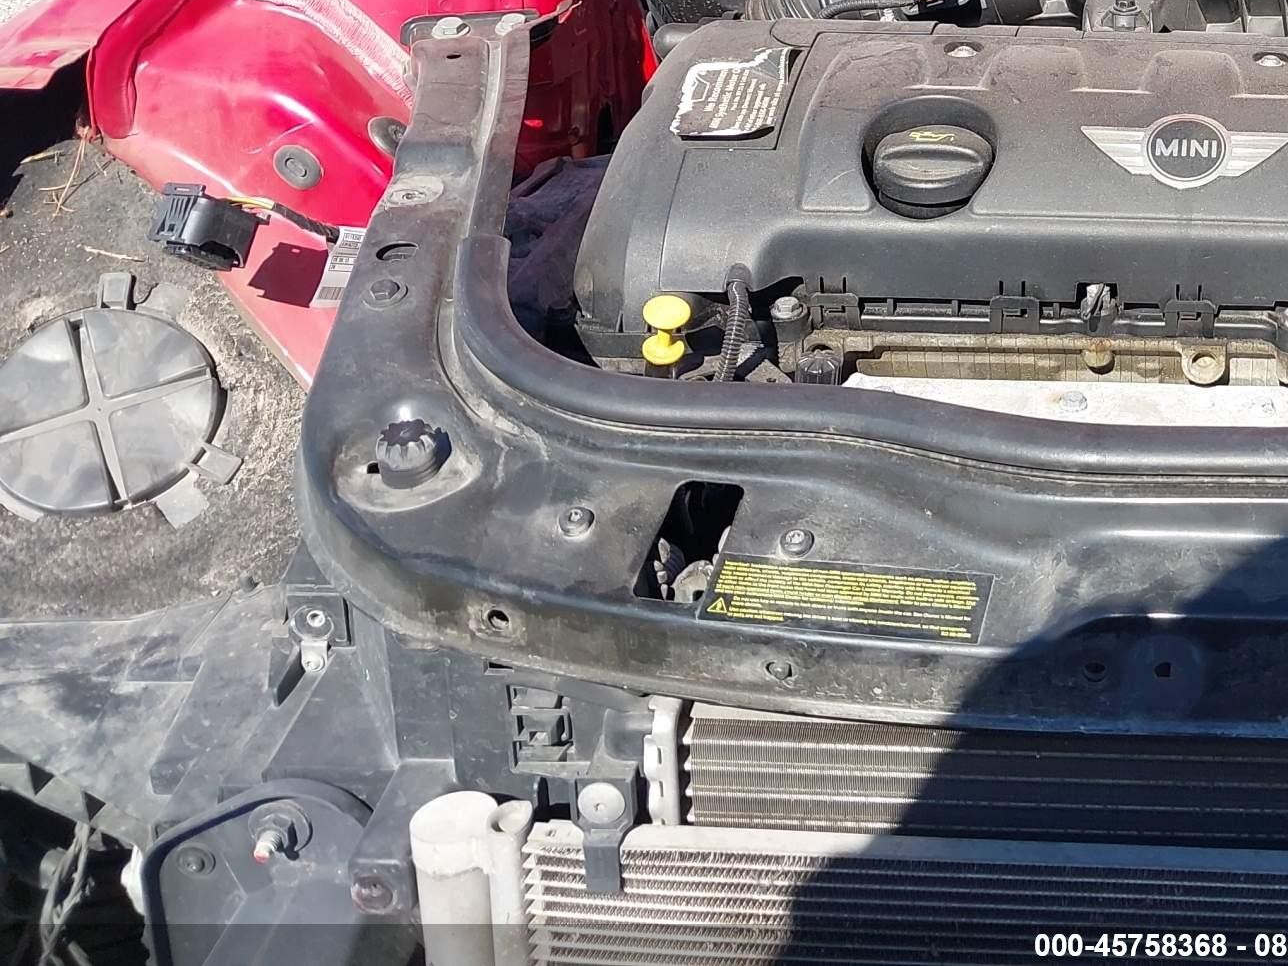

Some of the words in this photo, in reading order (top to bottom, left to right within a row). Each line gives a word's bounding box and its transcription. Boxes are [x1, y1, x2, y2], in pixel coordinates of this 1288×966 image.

[715, 91, 733, 118] Synthetic
[725, 74, 740, 92] Motor
[703, 101, 716, 112] We
[1155, 138, 1218, 158] MINI
